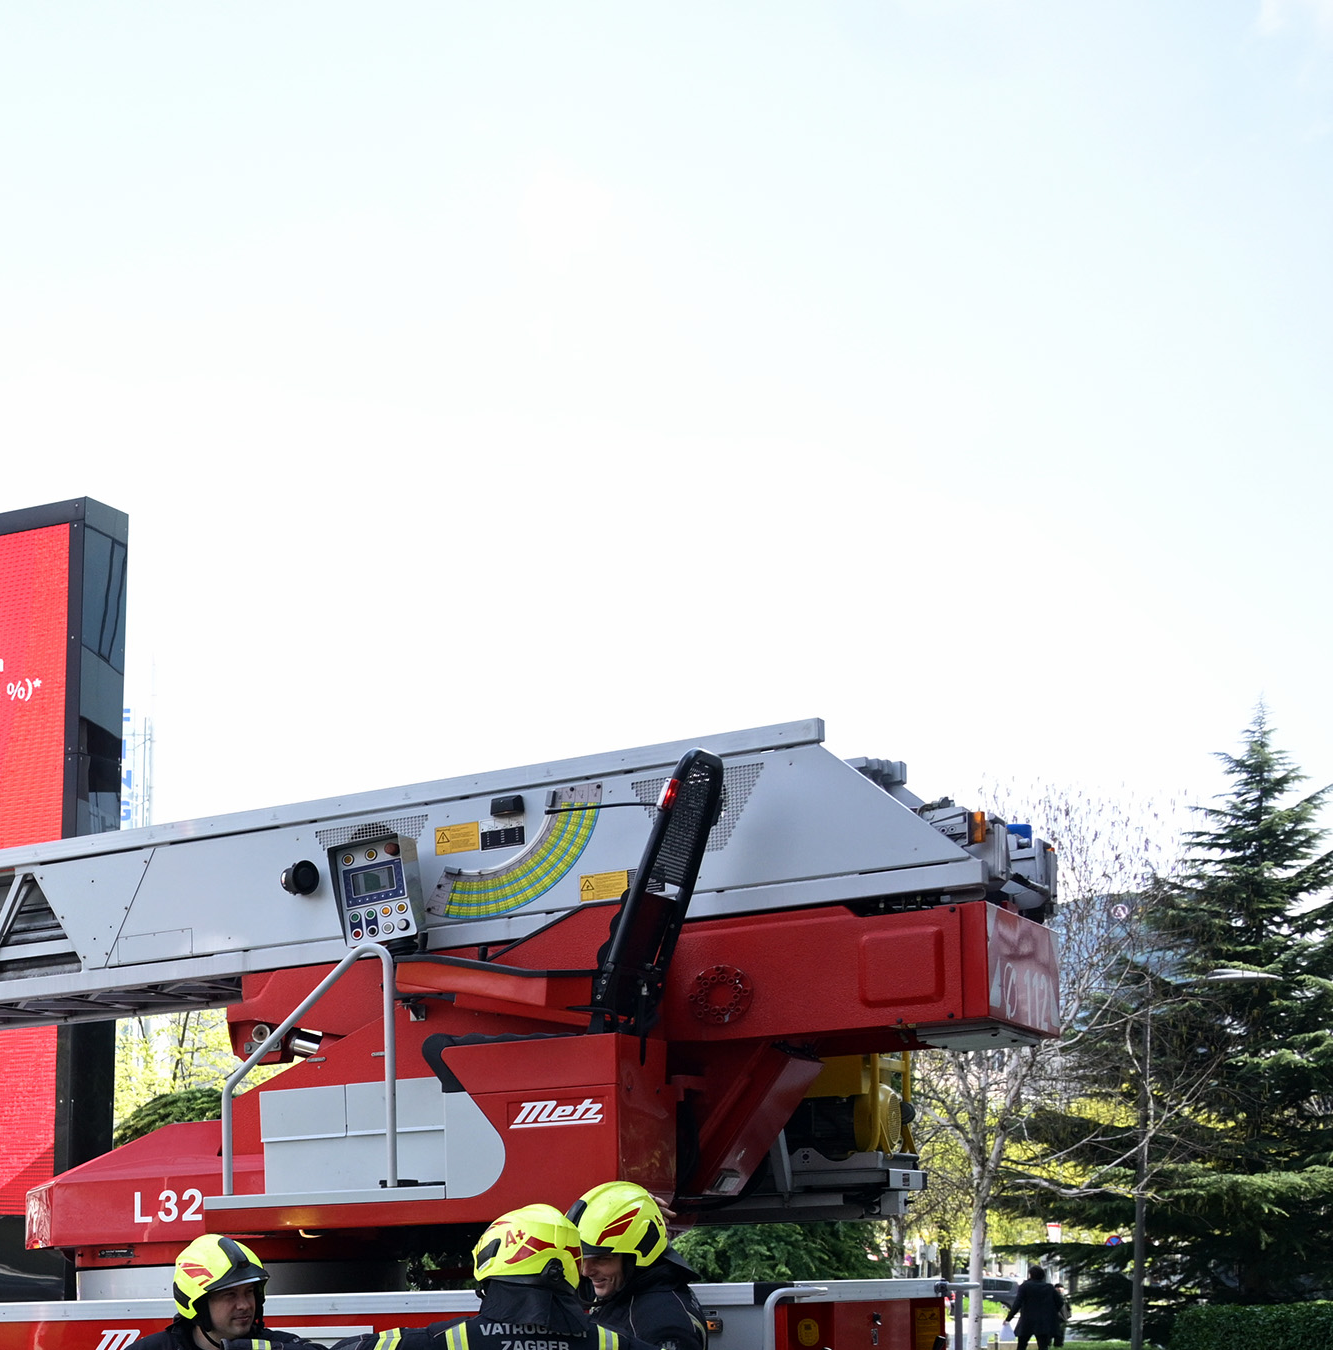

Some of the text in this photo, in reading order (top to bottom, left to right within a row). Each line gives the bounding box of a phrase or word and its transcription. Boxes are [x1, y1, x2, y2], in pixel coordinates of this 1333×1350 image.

[1024, 969, 1049, 1032] 112
[509, 1099, 603, 1129] Metz
[134, 1188, 203, 1223] L32
[505, 1229, 526, 1248] A+
